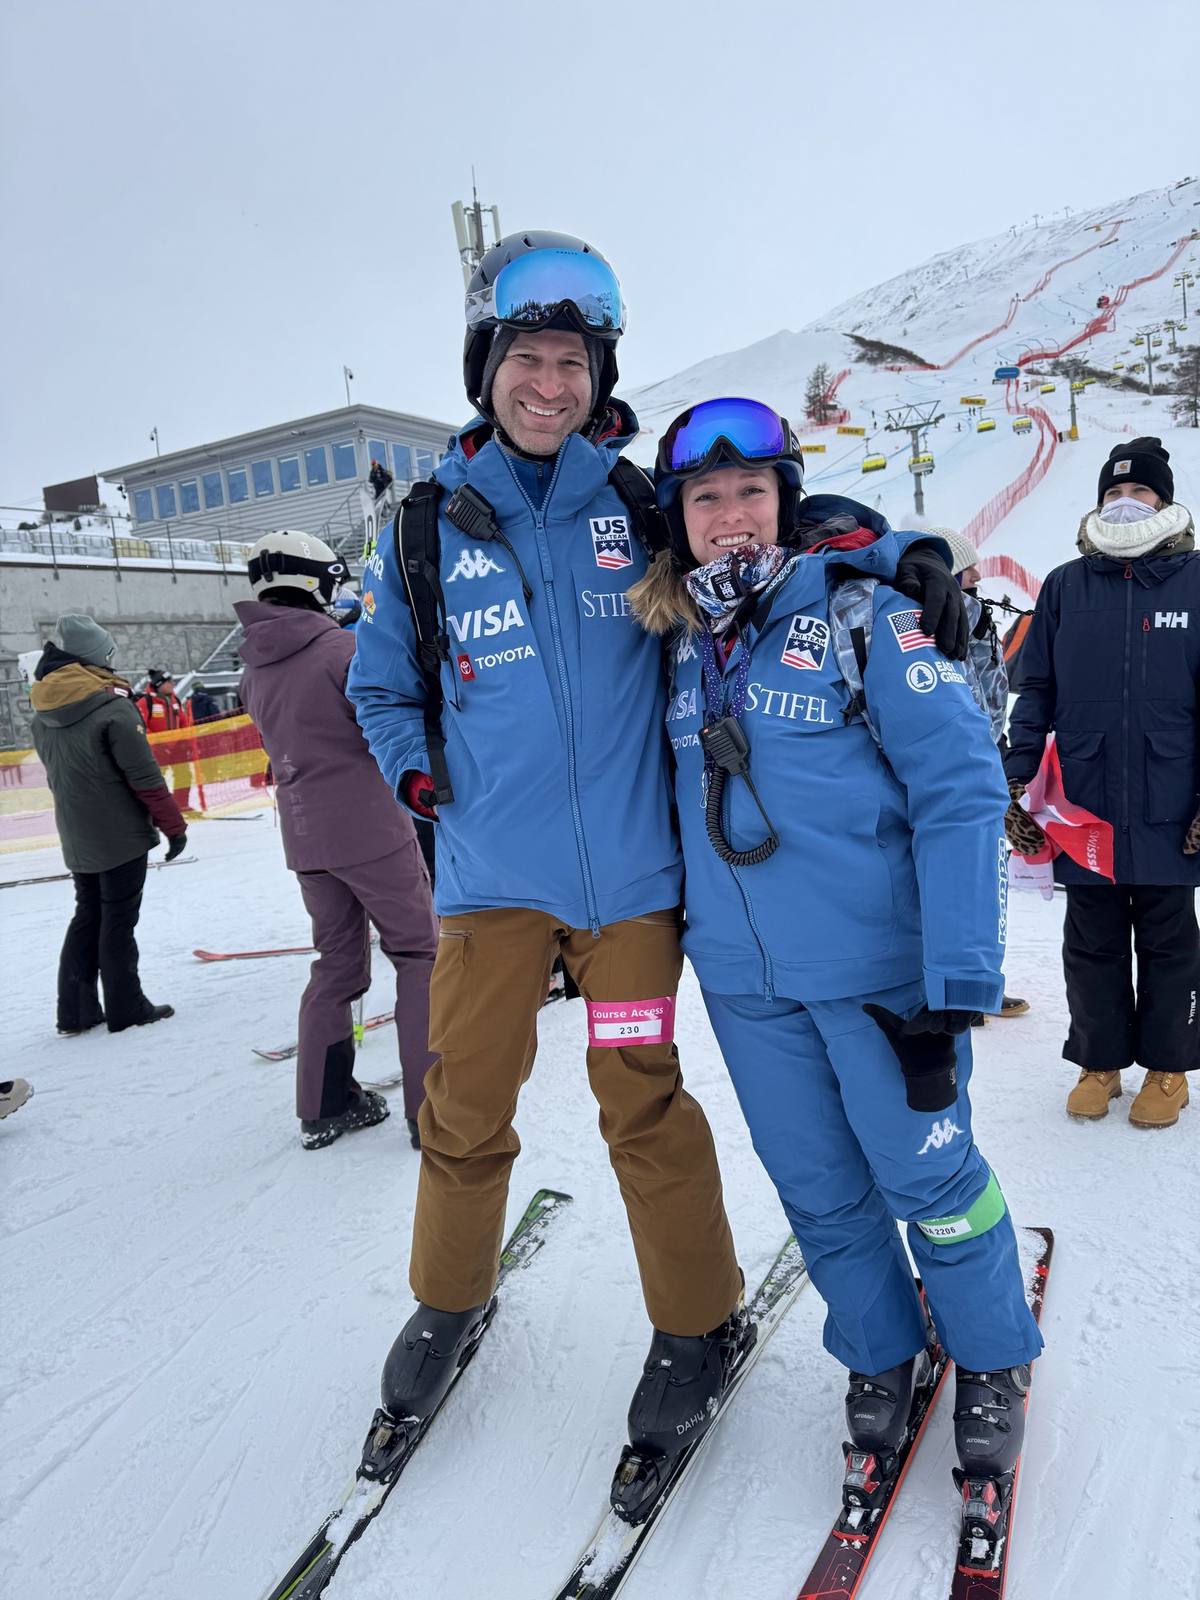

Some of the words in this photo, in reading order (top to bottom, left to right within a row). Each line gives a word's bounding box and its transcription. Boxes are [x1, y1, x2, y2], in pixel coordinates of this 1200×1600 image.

[593, 519, 626, 535] US
[609, 533, 628, 541] TEAM
[581, 590, 632, 618] STIF
[446, 599, 525, 642] VISA
[1154, 611, 1189, 629] HH
[793, 618, 828, 640] US
[805, 634, 826, 647] TEAM
[474, 644, 536, 671] TOYOTA
[745, 683, 834, 724] STIFEL
[592, 1008, 627, 1019] Course
[631, 1006, 664, 1018] Access
[619, 1025, 640, 1035] 230
[935, 1226, 956, 1236] 2206
